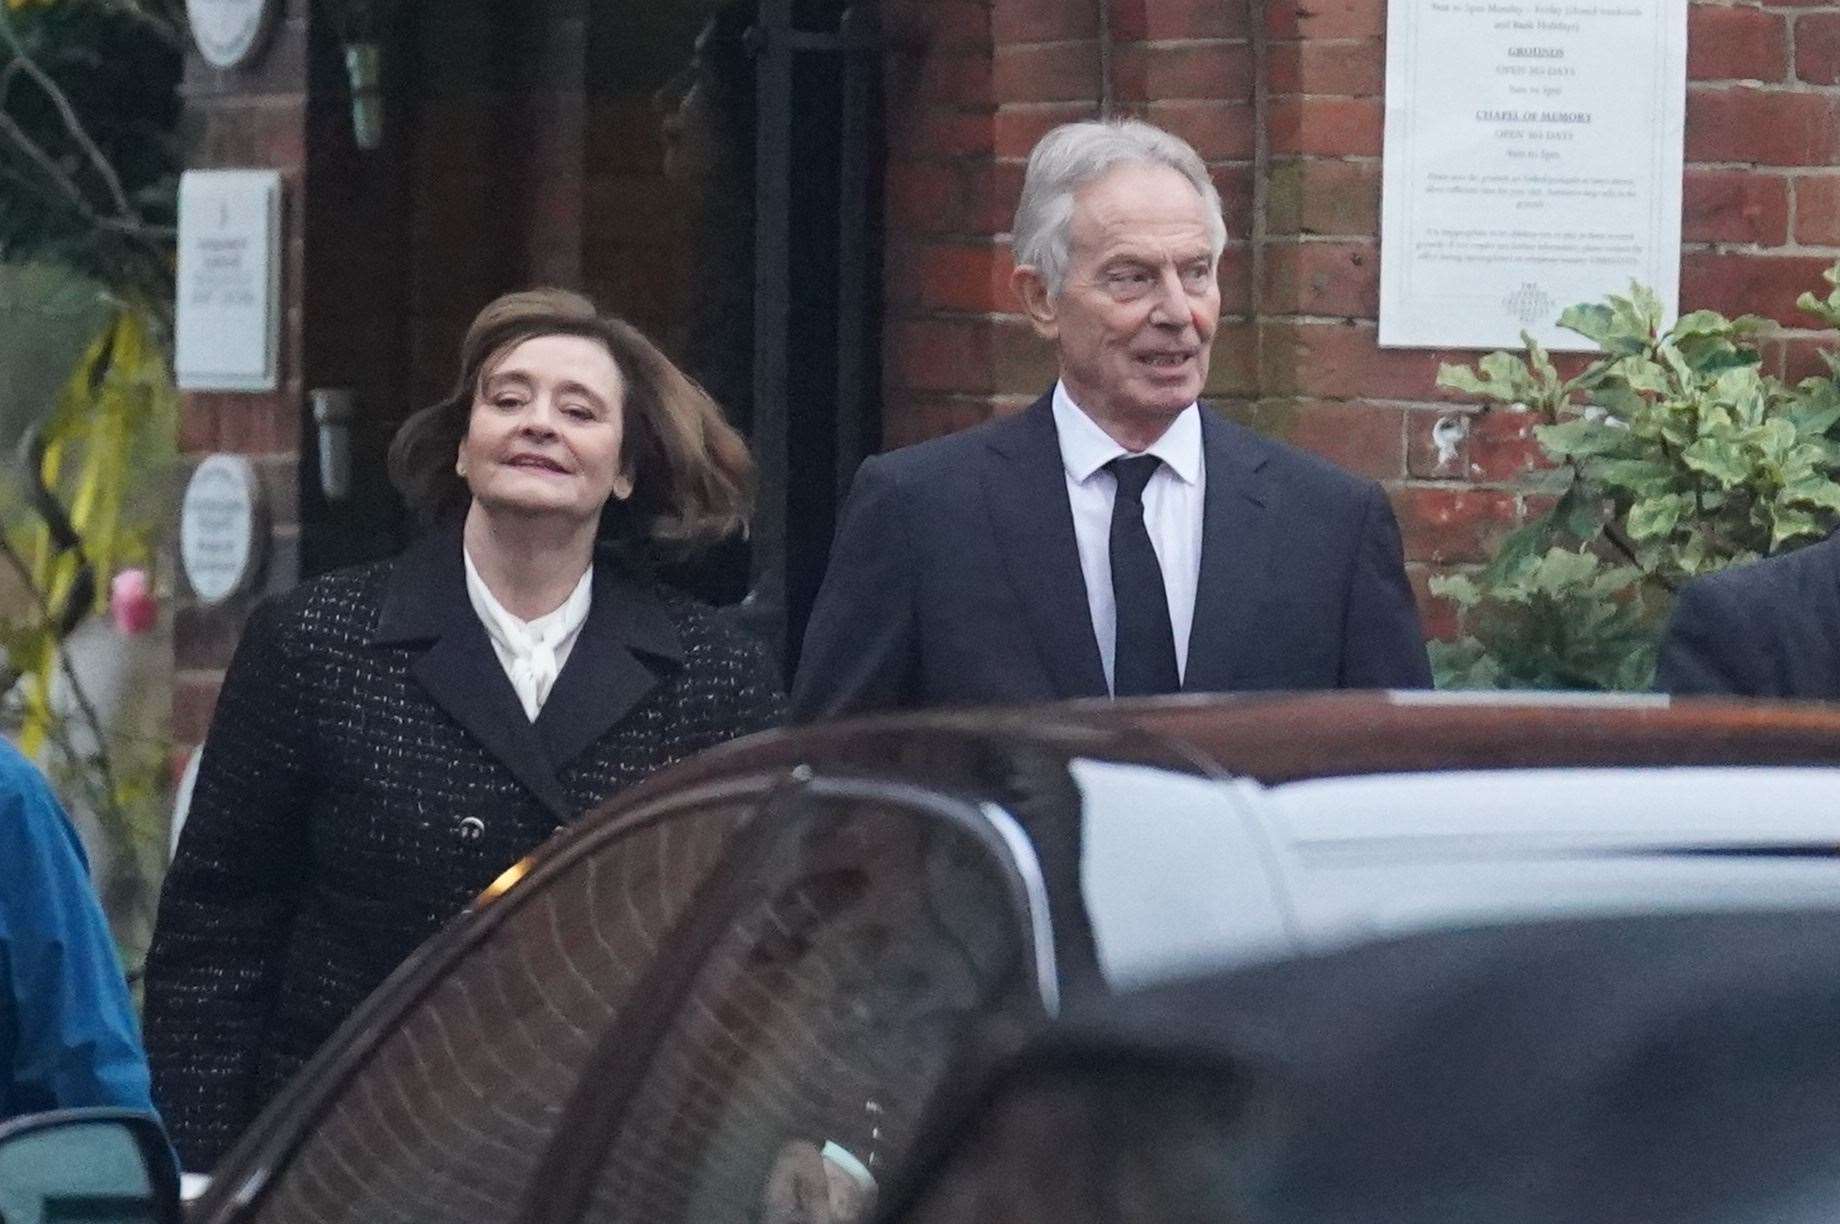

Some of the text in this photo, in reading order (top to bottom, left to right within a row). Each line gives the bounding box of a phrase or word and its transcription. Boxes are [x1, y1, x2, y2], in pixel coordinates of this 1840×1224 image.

[1507, 47, 1564, 58] GROUNDS
[1475, 110, 1592, 124] CHAPEL OF MEMORY
